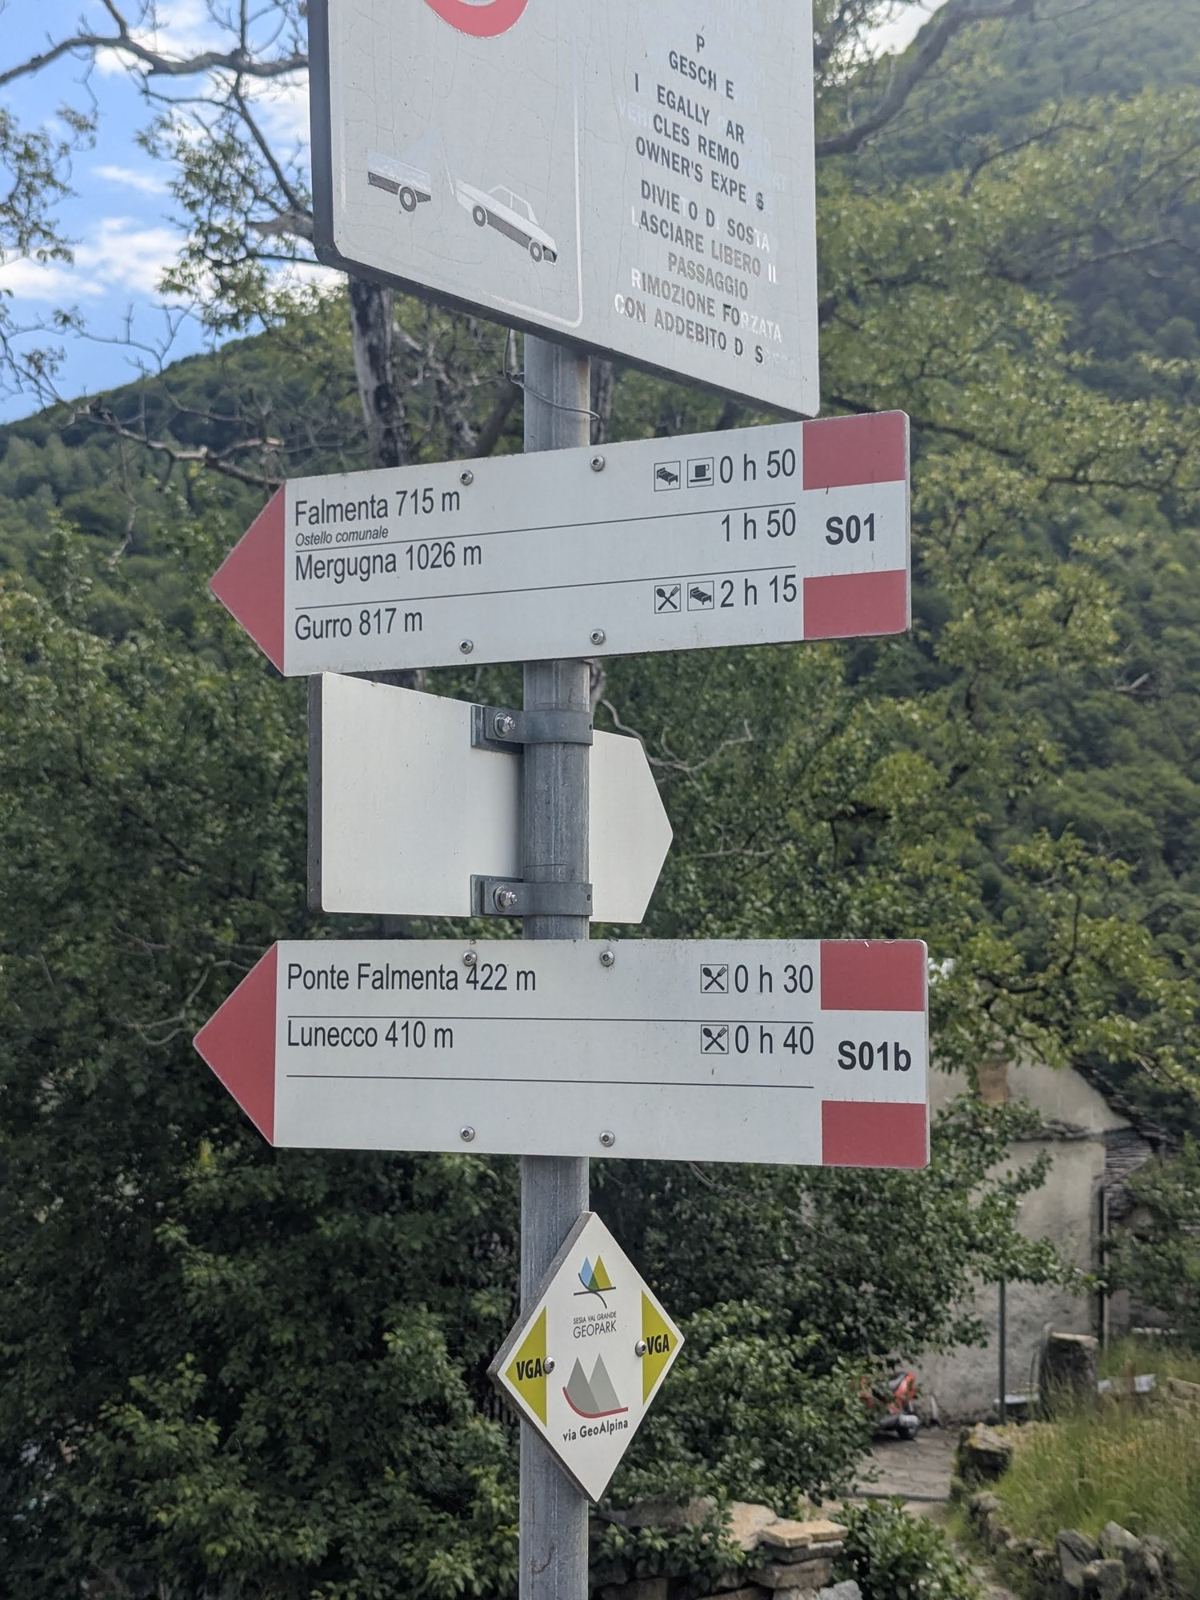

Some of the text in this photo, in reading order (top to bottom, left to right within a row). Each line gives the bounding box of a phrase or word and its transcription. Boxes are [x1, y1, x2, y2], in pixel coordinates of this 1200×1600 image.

[635, 136, 703, 183] OWNER'S
[698, 134, 739, 170] REMO
[631, 206, 704, 254] LASCIARE
[711, 240, 761, 277] LIBERO
[668, 252, 748, 300] PASSAGGIO
[614, 293, 647, 323] CON
[654, 308, 727, 350] ADDEBITO
[631, 267, 782, 343] RIMOZIONE FORZATA
[719, 448, 796, 484] 0 h 50
[295, 487, 460, 527] Falmenta 715 m
[295, 525, 389, 547] Ostello comunale
[721, 508, 796, 542] 1 h 50
[825, 512, 875, 546] S01
[295, 541, 482, 584] Mergugna 1026 m
[720, 574, 797, 608] 2 h 15
[295, 607, 423, 641] Gurro 817 m
[287, 963, 536, 991] Ponte Falmenta 422 m
[734, 964, 814, 994] 0 h 30
[287, 1019, 454, 1049] Lunecco 410 m
[734, 1025, 814, 1055] 0 h 40
[837, 1040, 912, 1072] S01b
[573, 1319, 617, 1339] GEOPARK
[597, 1310, 617, 1321] GRANDE
[646, 1334, 669, 1355] VGA
[516, 1358, 543, 1381] VGA
[562, 1419, 629, 1443] via GeoAlpina
